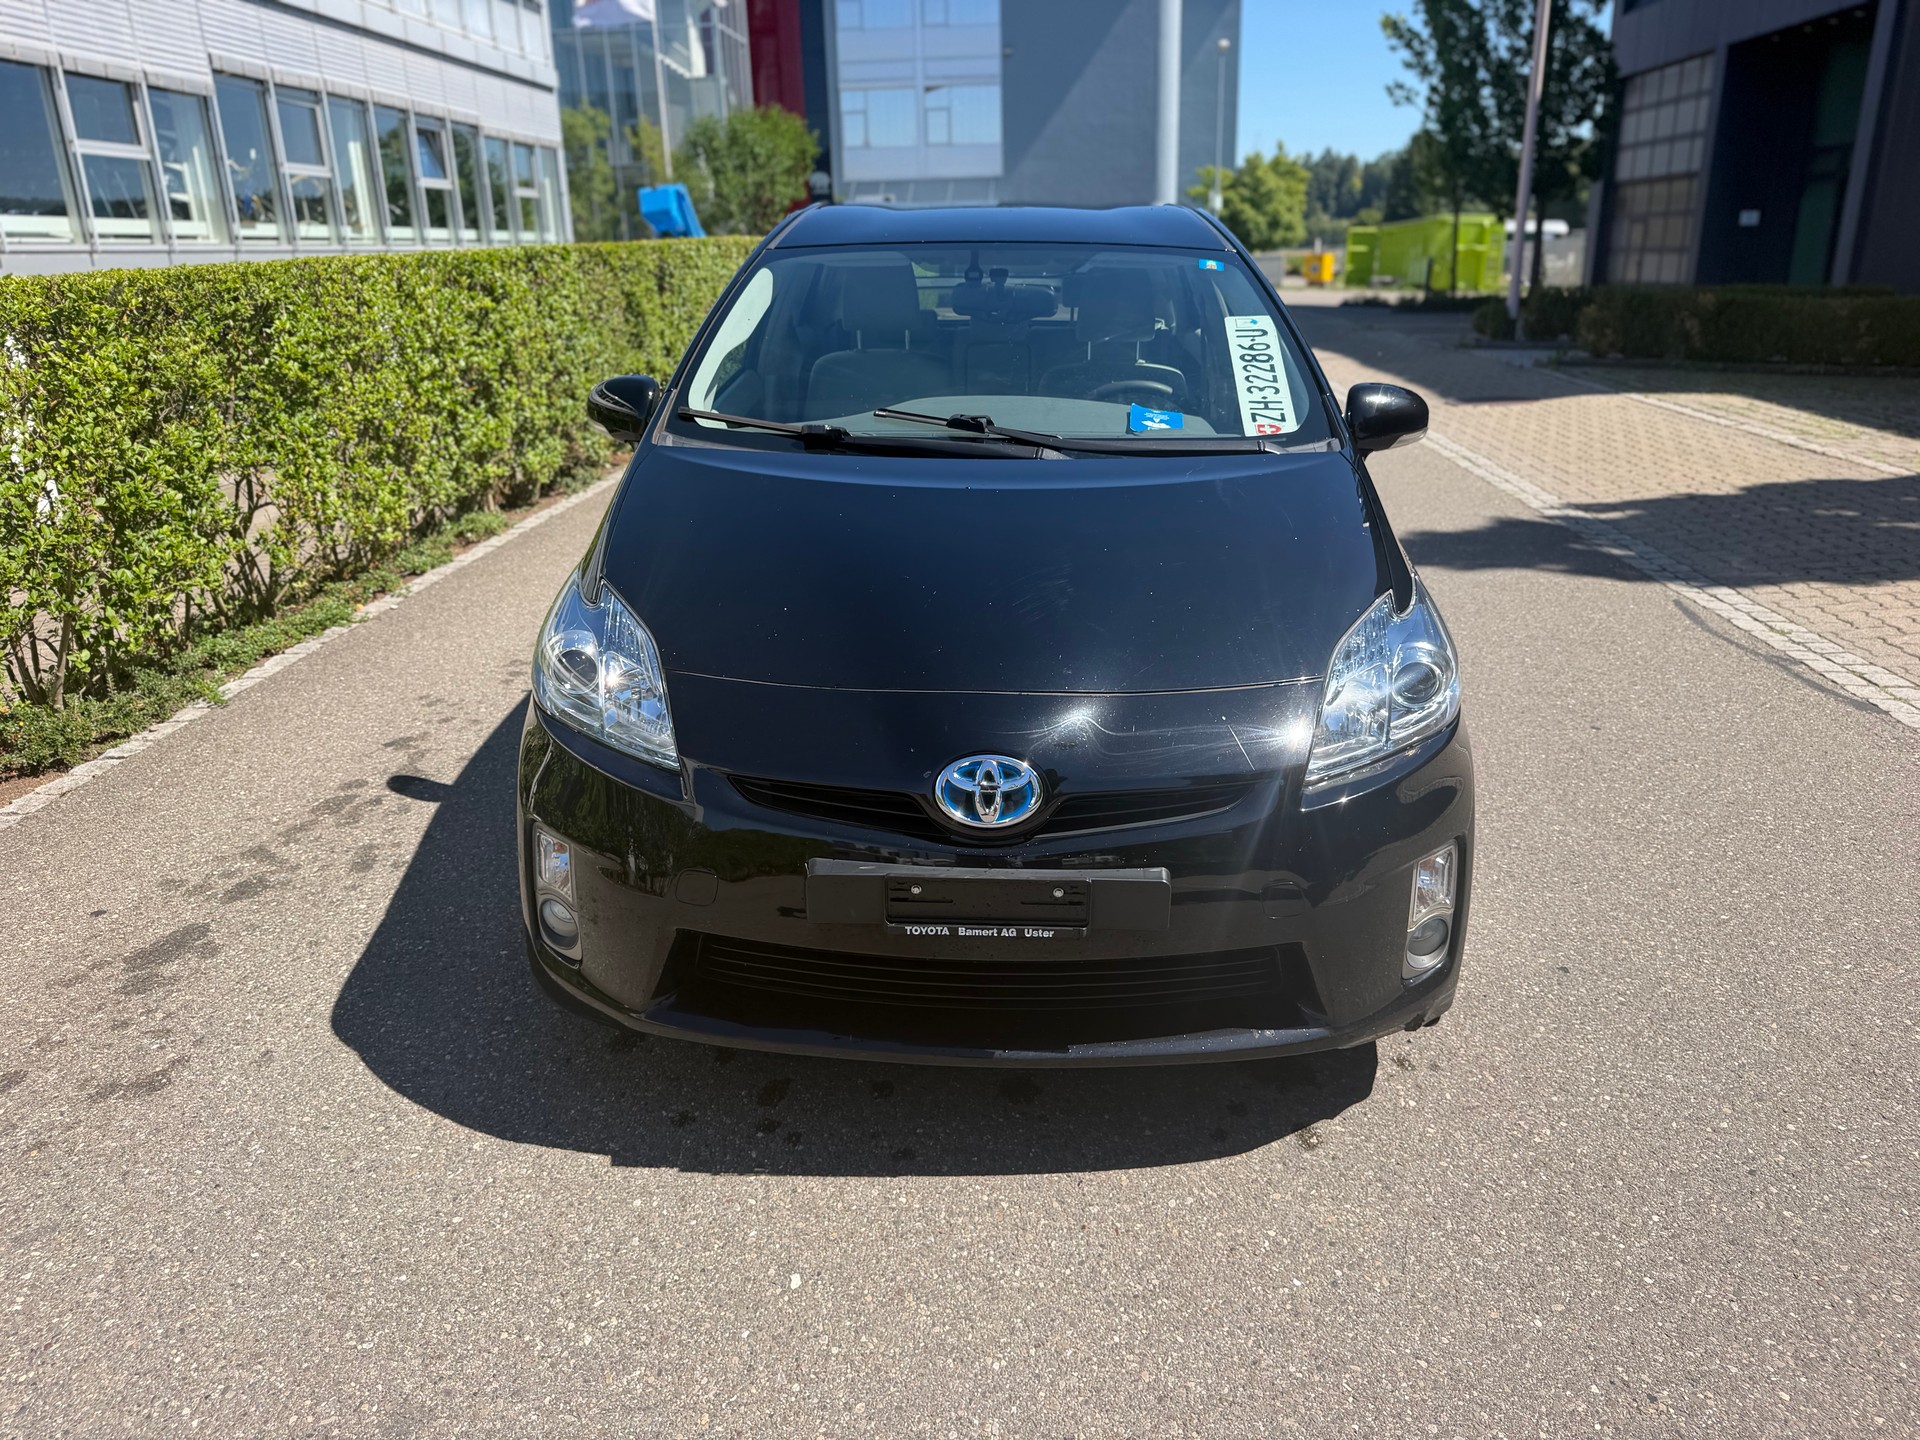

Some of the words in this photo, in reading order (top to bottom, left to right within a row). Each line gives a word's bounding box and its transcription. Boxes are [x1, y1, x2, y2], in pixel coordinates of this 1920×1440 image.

[905, 926, 950, 936] TOYOTA
[958, 927, 998, 937] Bamert
[1000, 928, 1017, 937] AG
[1024, 928, 1055, 938] Uster
